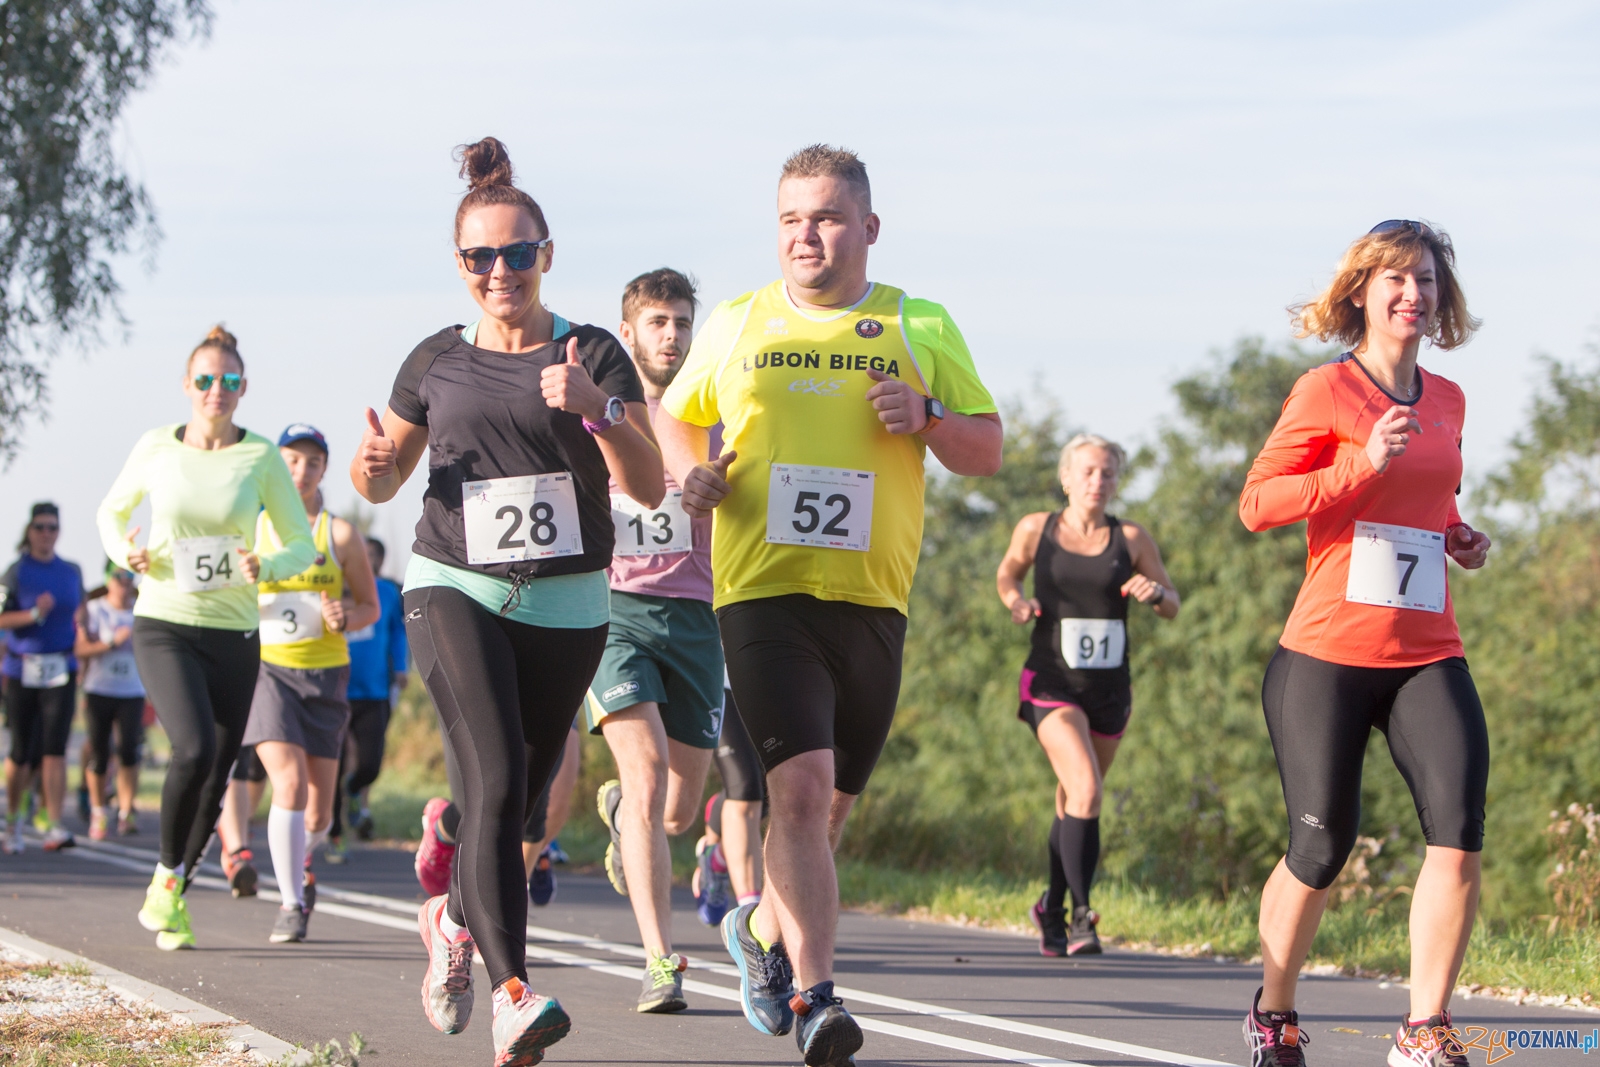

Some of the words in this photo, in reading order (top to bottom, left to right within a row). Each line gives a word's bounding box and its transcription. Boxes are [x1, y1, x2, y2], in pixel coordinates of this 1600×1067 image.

[743, 350, 820, 373] LUBOŃ
[829, 354, 900, 378] BIEGA
[495, 501, 558, 550] 28
[628, 512, 674, 546] 13
[792, 491, 851, 537] 52
[195, 552, 233, 582] 54
[1397, 552, 1419, 596] 7
[282, 609, 298, 634] 3
[1080, 635, 1109, 660] 91
